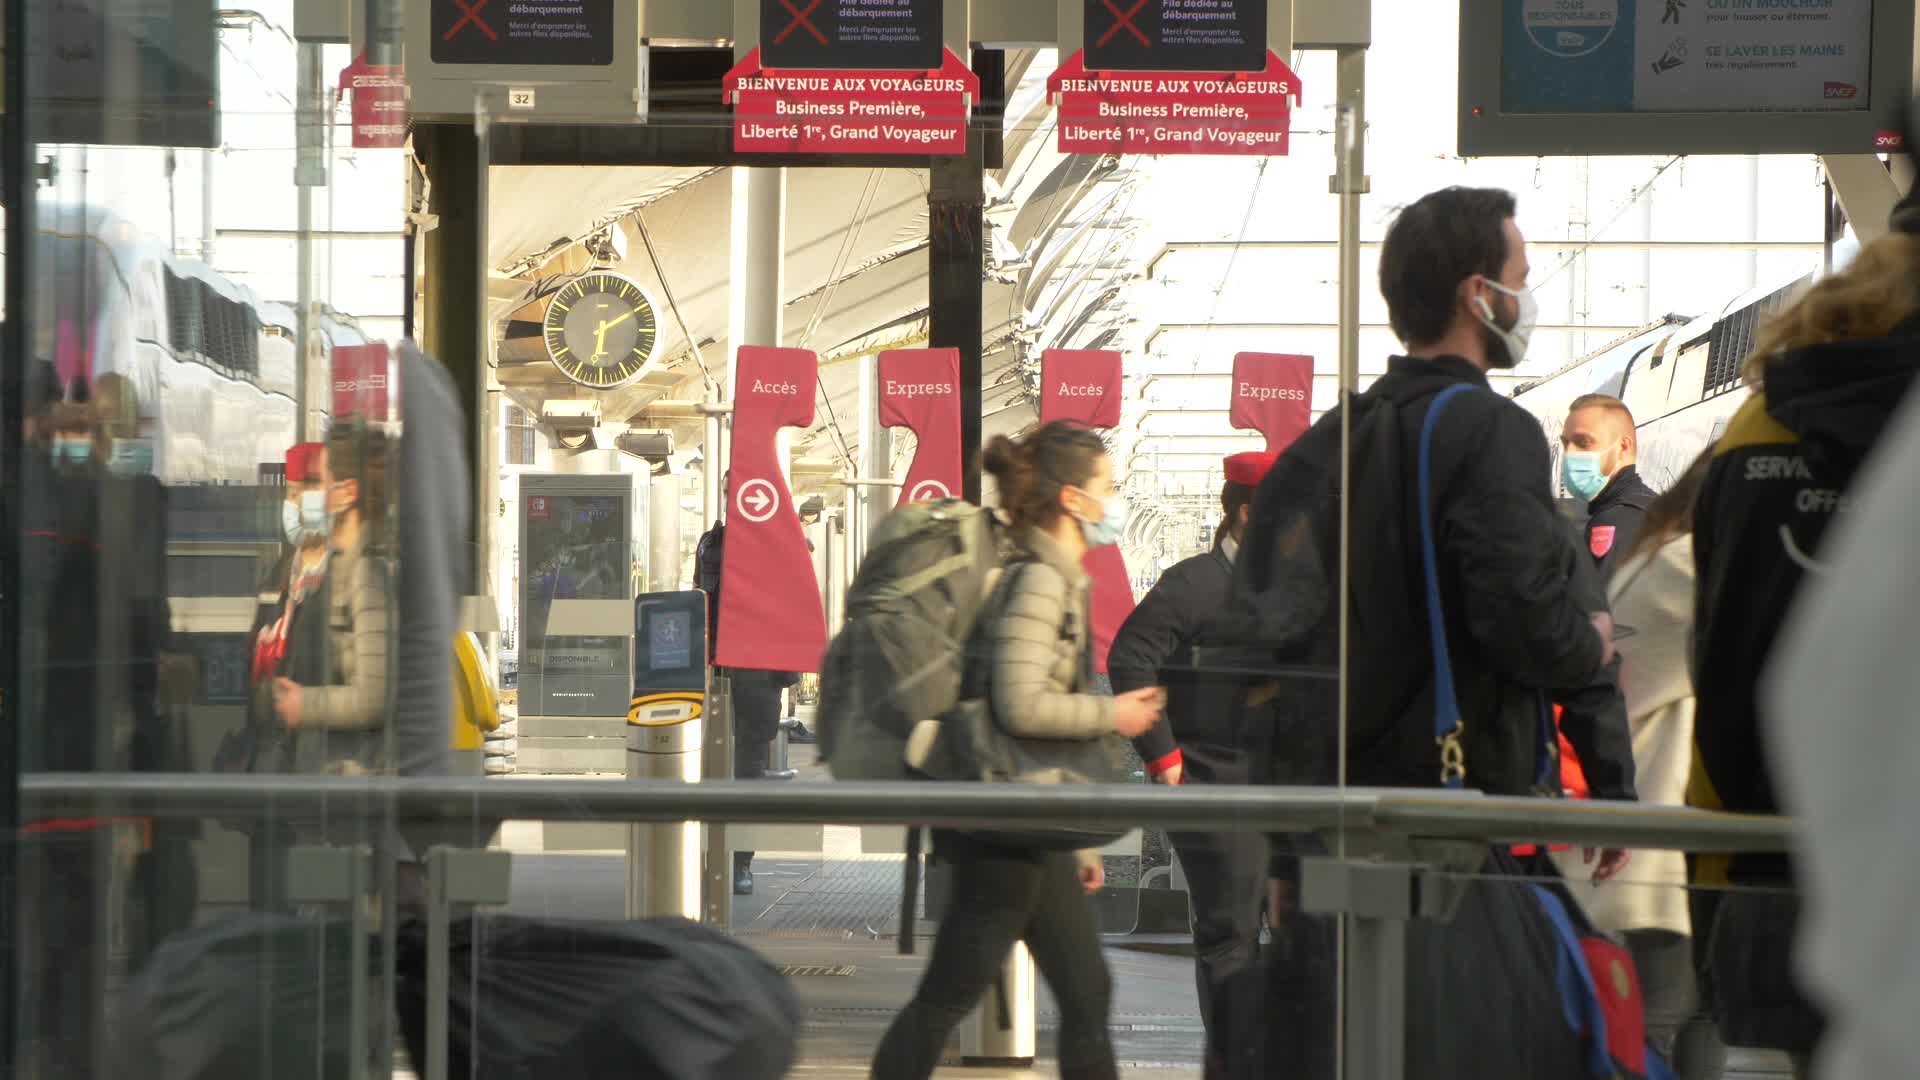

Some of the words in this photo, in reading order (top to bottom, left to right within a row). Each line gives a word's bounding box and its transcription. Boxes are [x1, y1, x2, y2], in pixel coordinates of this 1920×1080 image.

[509, 4, 584, 16] débarquement
[839, 8, 913, 19] débarquement
[1162, 10, 1237, 21] débarquement
[1706, 13, 1728, 22] pour
[840, 25, 859, 33] Merci
[1705, 45, 1721, 57] SE
[1725, 45, 1769, 57] LAVER
[1771, 45, 1796, 57] LES
[1799, 44, 1847, 57] MAINS
[737, 78, 829, 91] BIENVENUE
[832, 79, 866, 91] AUX
[870, 79, 964, 92] VOYAGEURS
[1061, 79, 1153, 93] BIENVENUE
[1156, 81, 1189, 93] AUX
[1193, 81, 1288, 94] VOYAGEURS
[514, 94, 529, 104] 32
[776, 100, 844, 115] Business
[849, 101, 925, 118] Première,
[1099, 102, 1168, 117] Business
[1172, 102, 1249, 120] Première,
[741, 123, 798, 139] Liberté
[830, 124, 878, 139] Grand
[882, 126, 957, 143] Voyageur
[1064, 126, 1121, 141] Liberté
[1154, 127, 1202, 142] Grand
[1206, 128, 1282, 145] Voyageur
[752, 379, 798, 394] Accès
[886, 380, 951, 398] Express
[1058, 382, 1104, 396] Accès
[1239, 382, 1305, 401] Express
